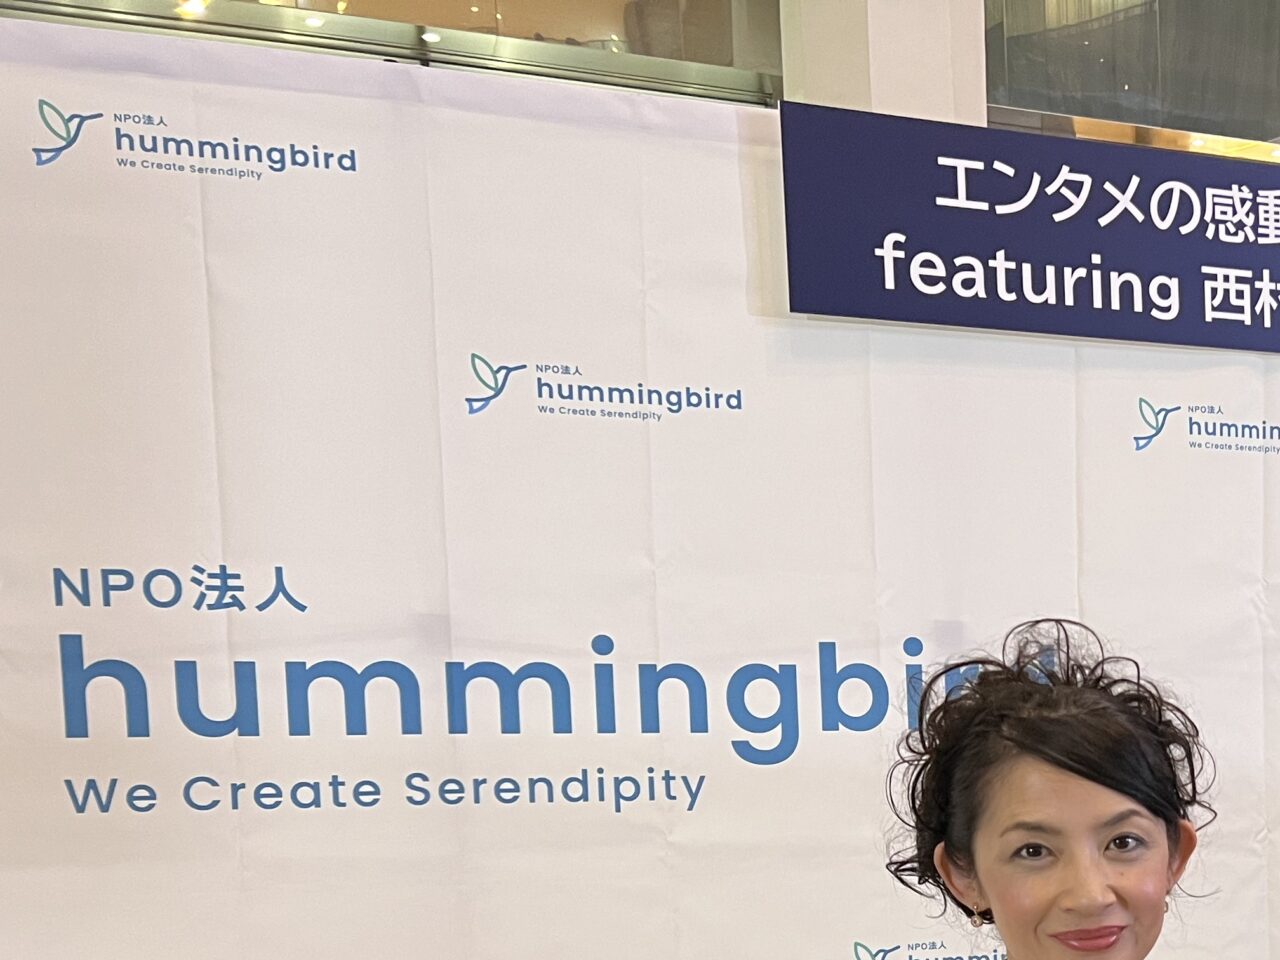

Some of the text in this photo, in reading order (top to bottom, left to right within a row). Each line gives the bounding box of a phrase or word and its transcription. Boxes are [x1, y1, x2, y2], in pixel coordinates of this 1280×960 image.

[113, 112, 168, 127] NPO法人
[115, 127, 357, 172] hummingbird
[116, 157, 263, 181] We Create Serendipity
[874, 232, 1180, 321] featuring
[536, 364, 583, 376] NPO法人
[536, 376, 742, 414] hummingbird
[537, 405, 663, 422] We Create Serendipity
[53, 564, 308, 613] NPO法人
[67, 768, 706, 813] We Create Serendipity
